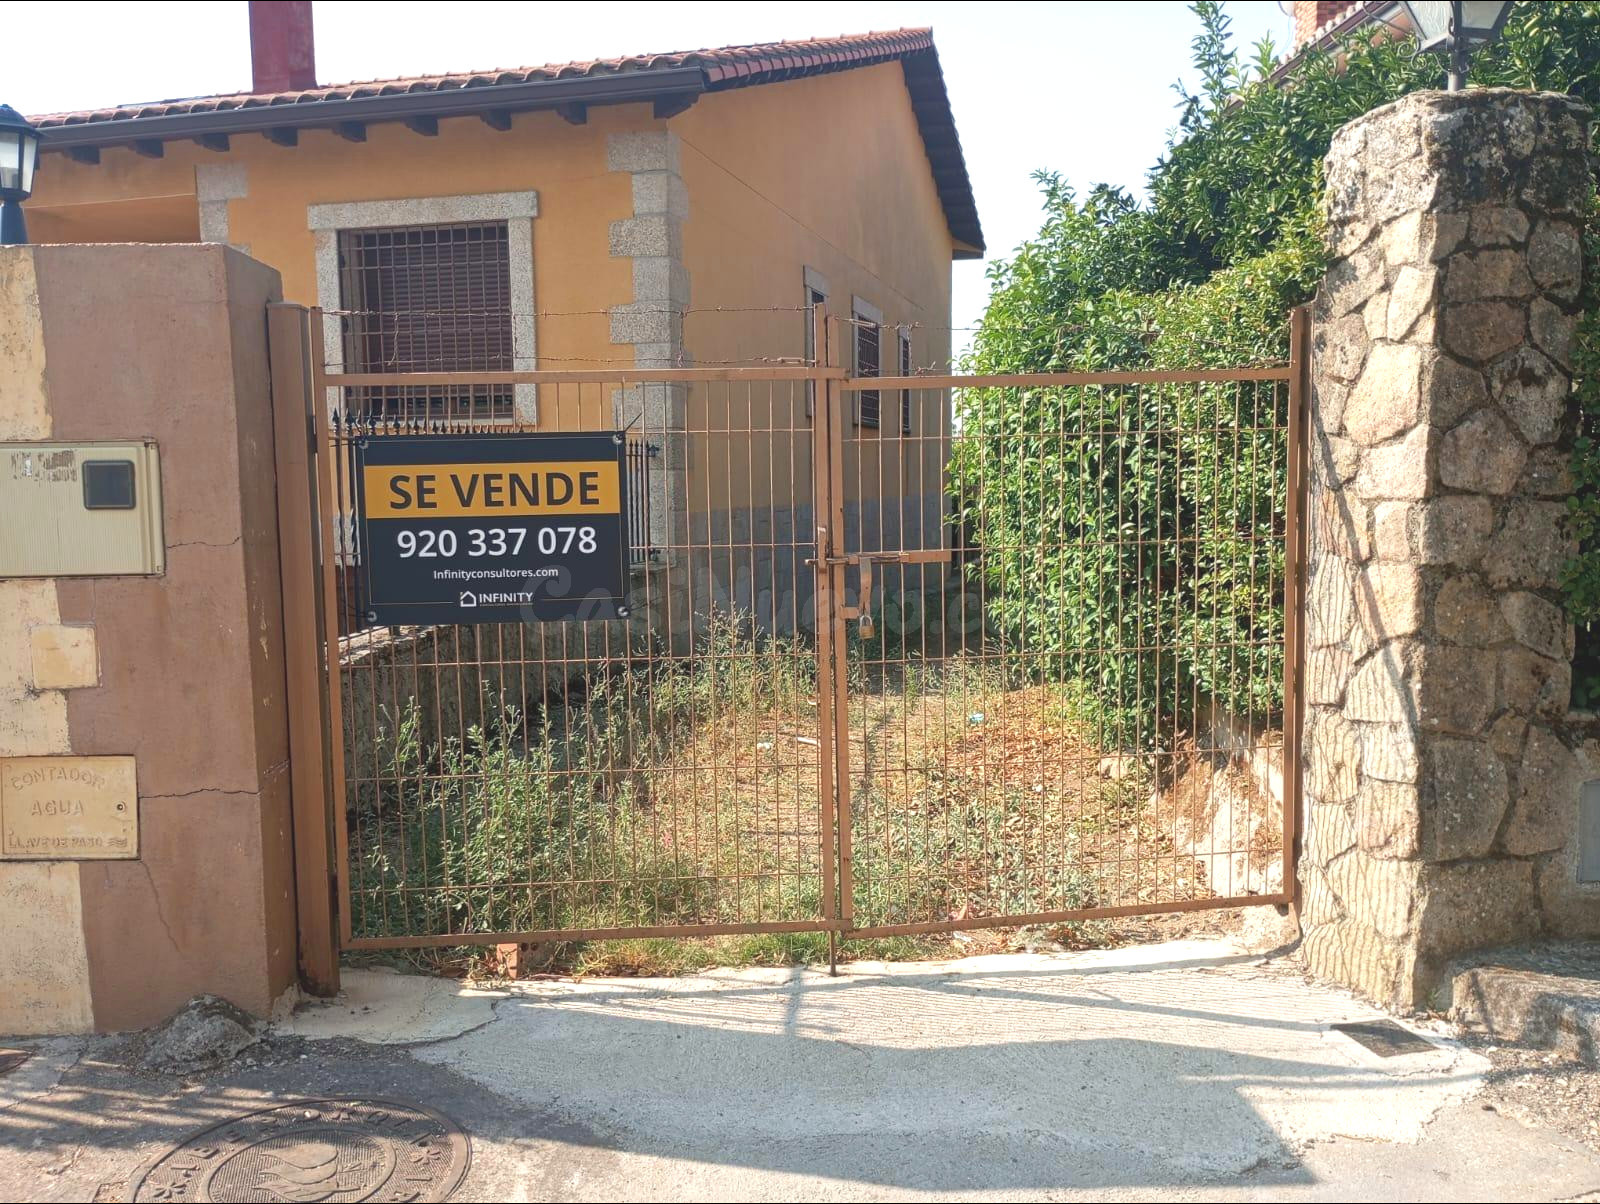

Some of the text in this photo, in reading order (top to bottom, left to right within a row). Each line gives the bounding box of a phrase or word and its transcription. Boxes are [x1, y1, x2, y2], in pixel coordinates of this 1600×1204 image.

[389, 471, 600, 510] SE VENDE
[397, 526, 597, 558] 920 337 078
[433, 567, 559, 581] Infinityconsultores.com
[479, 592, 533, 604] INFINITY
[31, 799, 85, 817] AGUA
